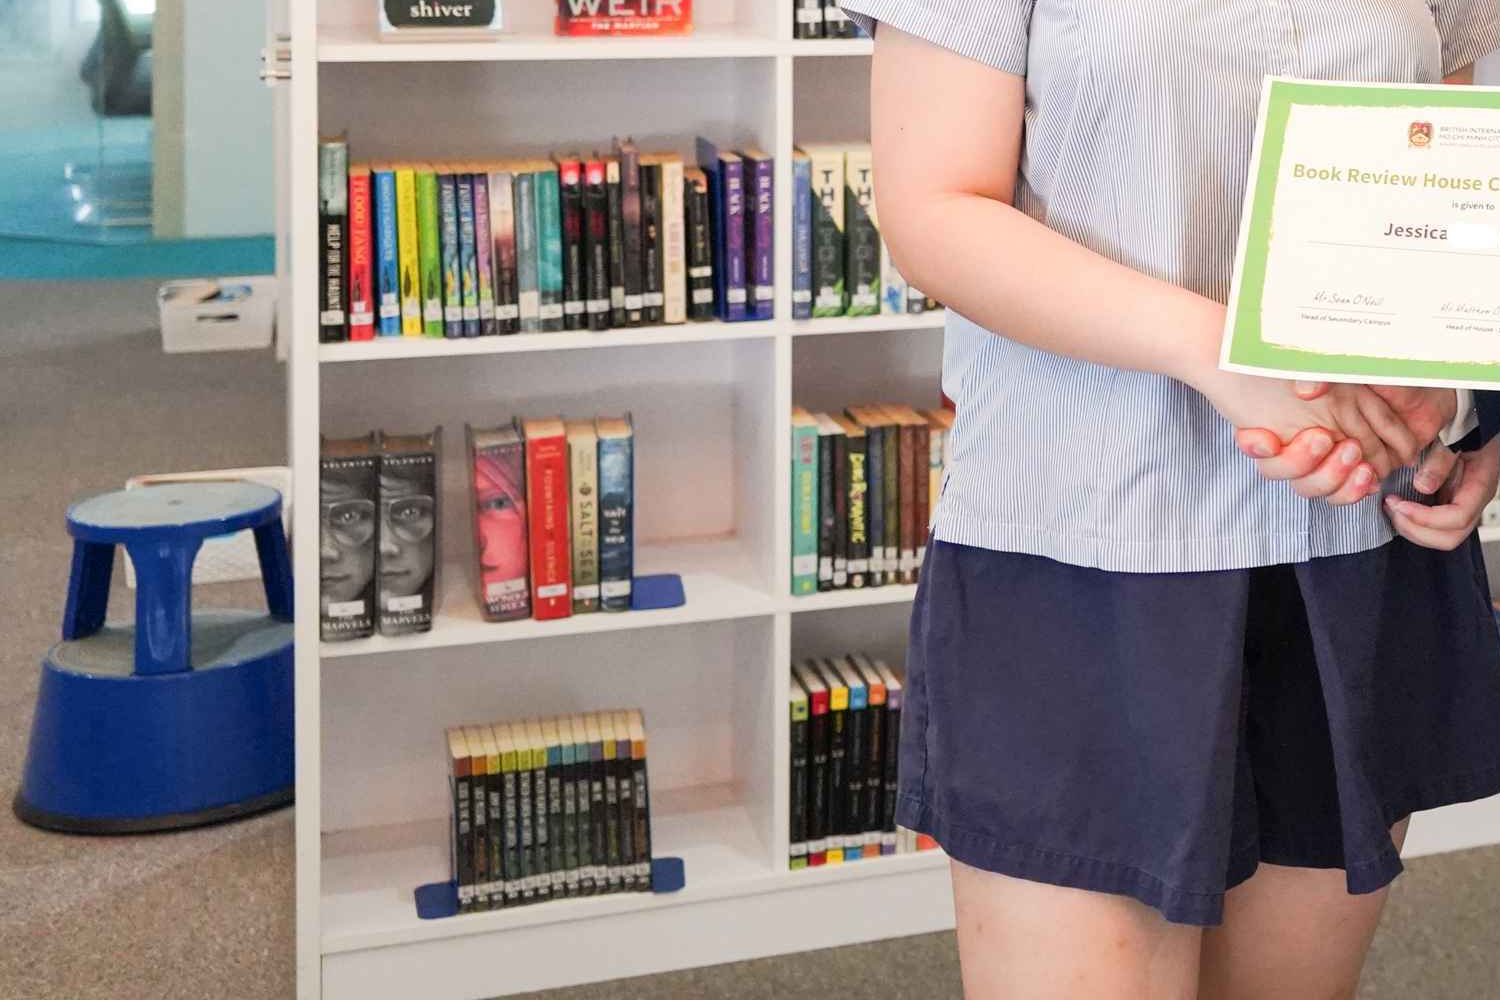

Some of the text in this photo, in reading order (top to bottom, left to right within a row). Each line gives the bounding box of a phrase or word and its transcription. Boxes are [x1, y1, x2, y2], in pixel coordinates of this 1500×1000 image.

[410, 0, 473, 19] shiver
[1293, 163, 1341, 182] Book
[1347, 168, 1417, 187] Review
[1423, 172, 1483, 191] House
[353, 181, 366, 223] FLOOD
[729, 177, 741, 215] BLACK
[759, 175, 772, 213] BLACK
[1452, 200, 1496, 211] is given to
[327, 224, 341, 249] HELP
[1384, 223, 1448, 240] Jessica
[327, 278, 341, 313] HAUNT
[1301, 313, 1318, 321] Head
[1328, 315, 1363, 325] Secondary
[1364, 318, 1391, 327] Campus
[1446, 323, 1463, 331] Head
[580, 501, 593, 537] SALT
[580, 550, 593, 581] SEA
